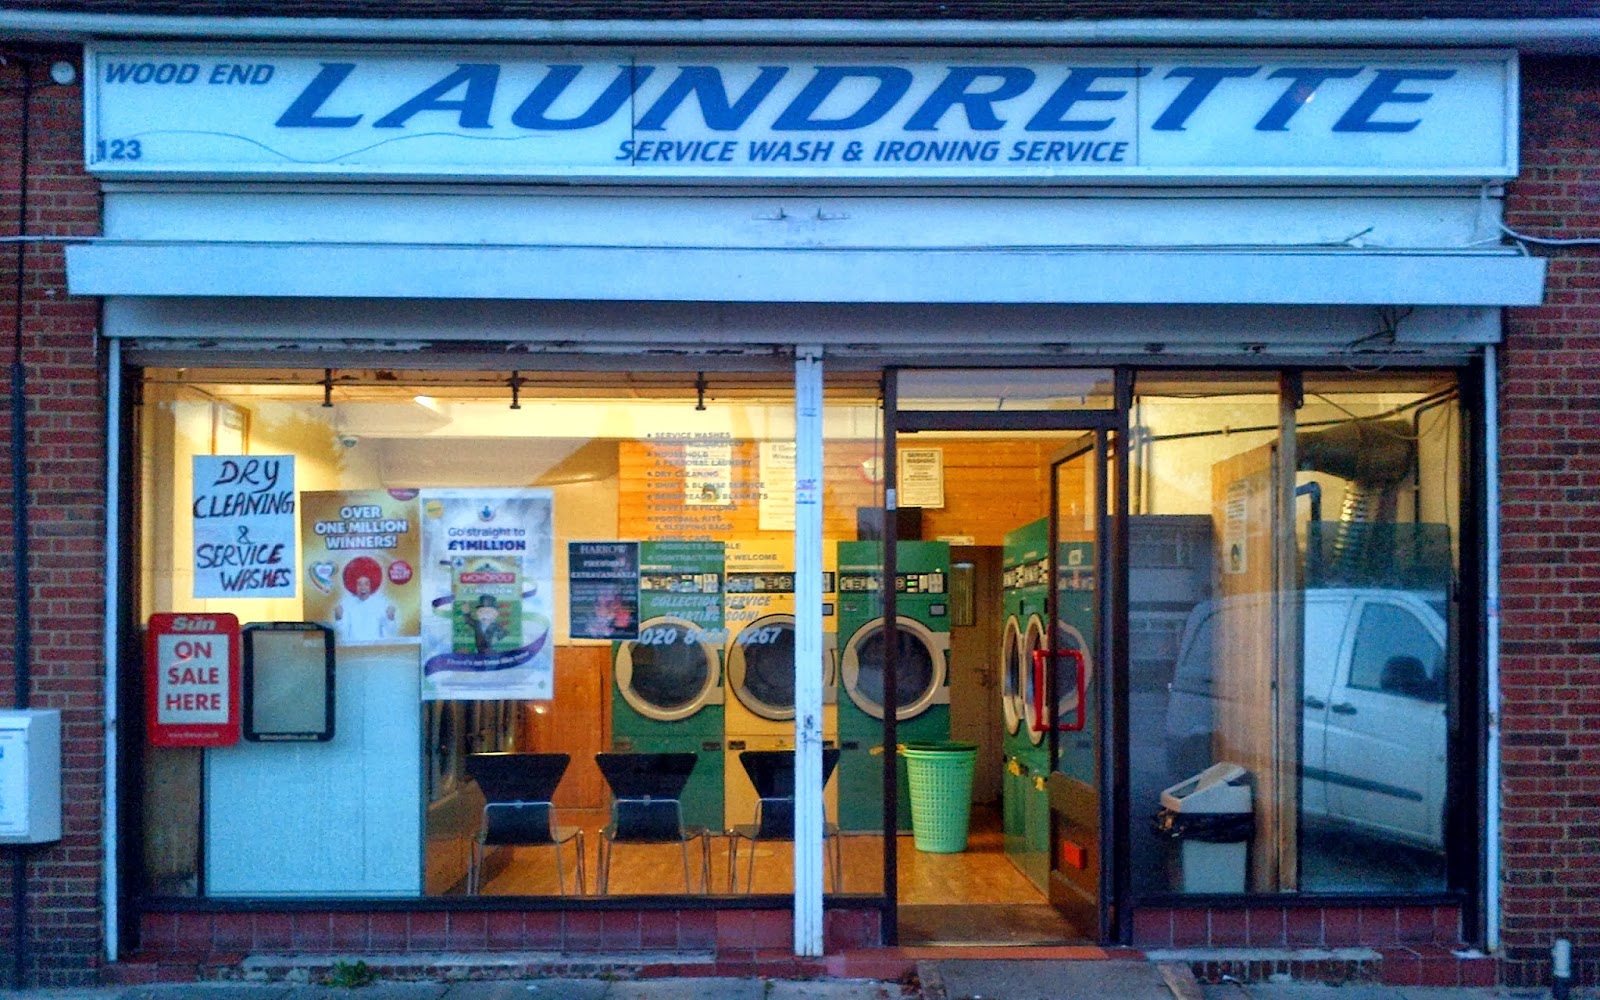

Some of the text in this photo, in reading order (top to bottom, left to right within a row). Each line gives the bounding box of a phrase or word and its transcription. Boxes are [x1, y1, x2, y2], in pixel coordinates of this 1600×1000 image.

[104, 63, 275, 86] WOOD END
[275, 62, 1457, 132] LAUNDRETTE
[98, 140, 142, 160] 123
[615, 141, 1130, 163] SERVICE WASH & IRONING SERVICE
[214, 459, 280, 492] DRY
[193, 491, 295, 519] CLEANING
[341, 506, 381, 519] OVER
[238, 525, 252, 545] &
[314, 520, 408, 534] ONE MILLION
[448, 527, 526, 539] Go straight to
[326, 535, 397, 550] WINNERS!
[197, 543, 283, 569] SERVICE
[219, 568, 291, 592] WASHES
[725, 595, 771, 606] SERVICE
[172, 617, 216, 630] Sun
[641, 627, 678, 646] 020
[174, 641, 212, 659] ON
[167, 667, 220, 685] SALE
[165, 693, 221, 711] HERE
